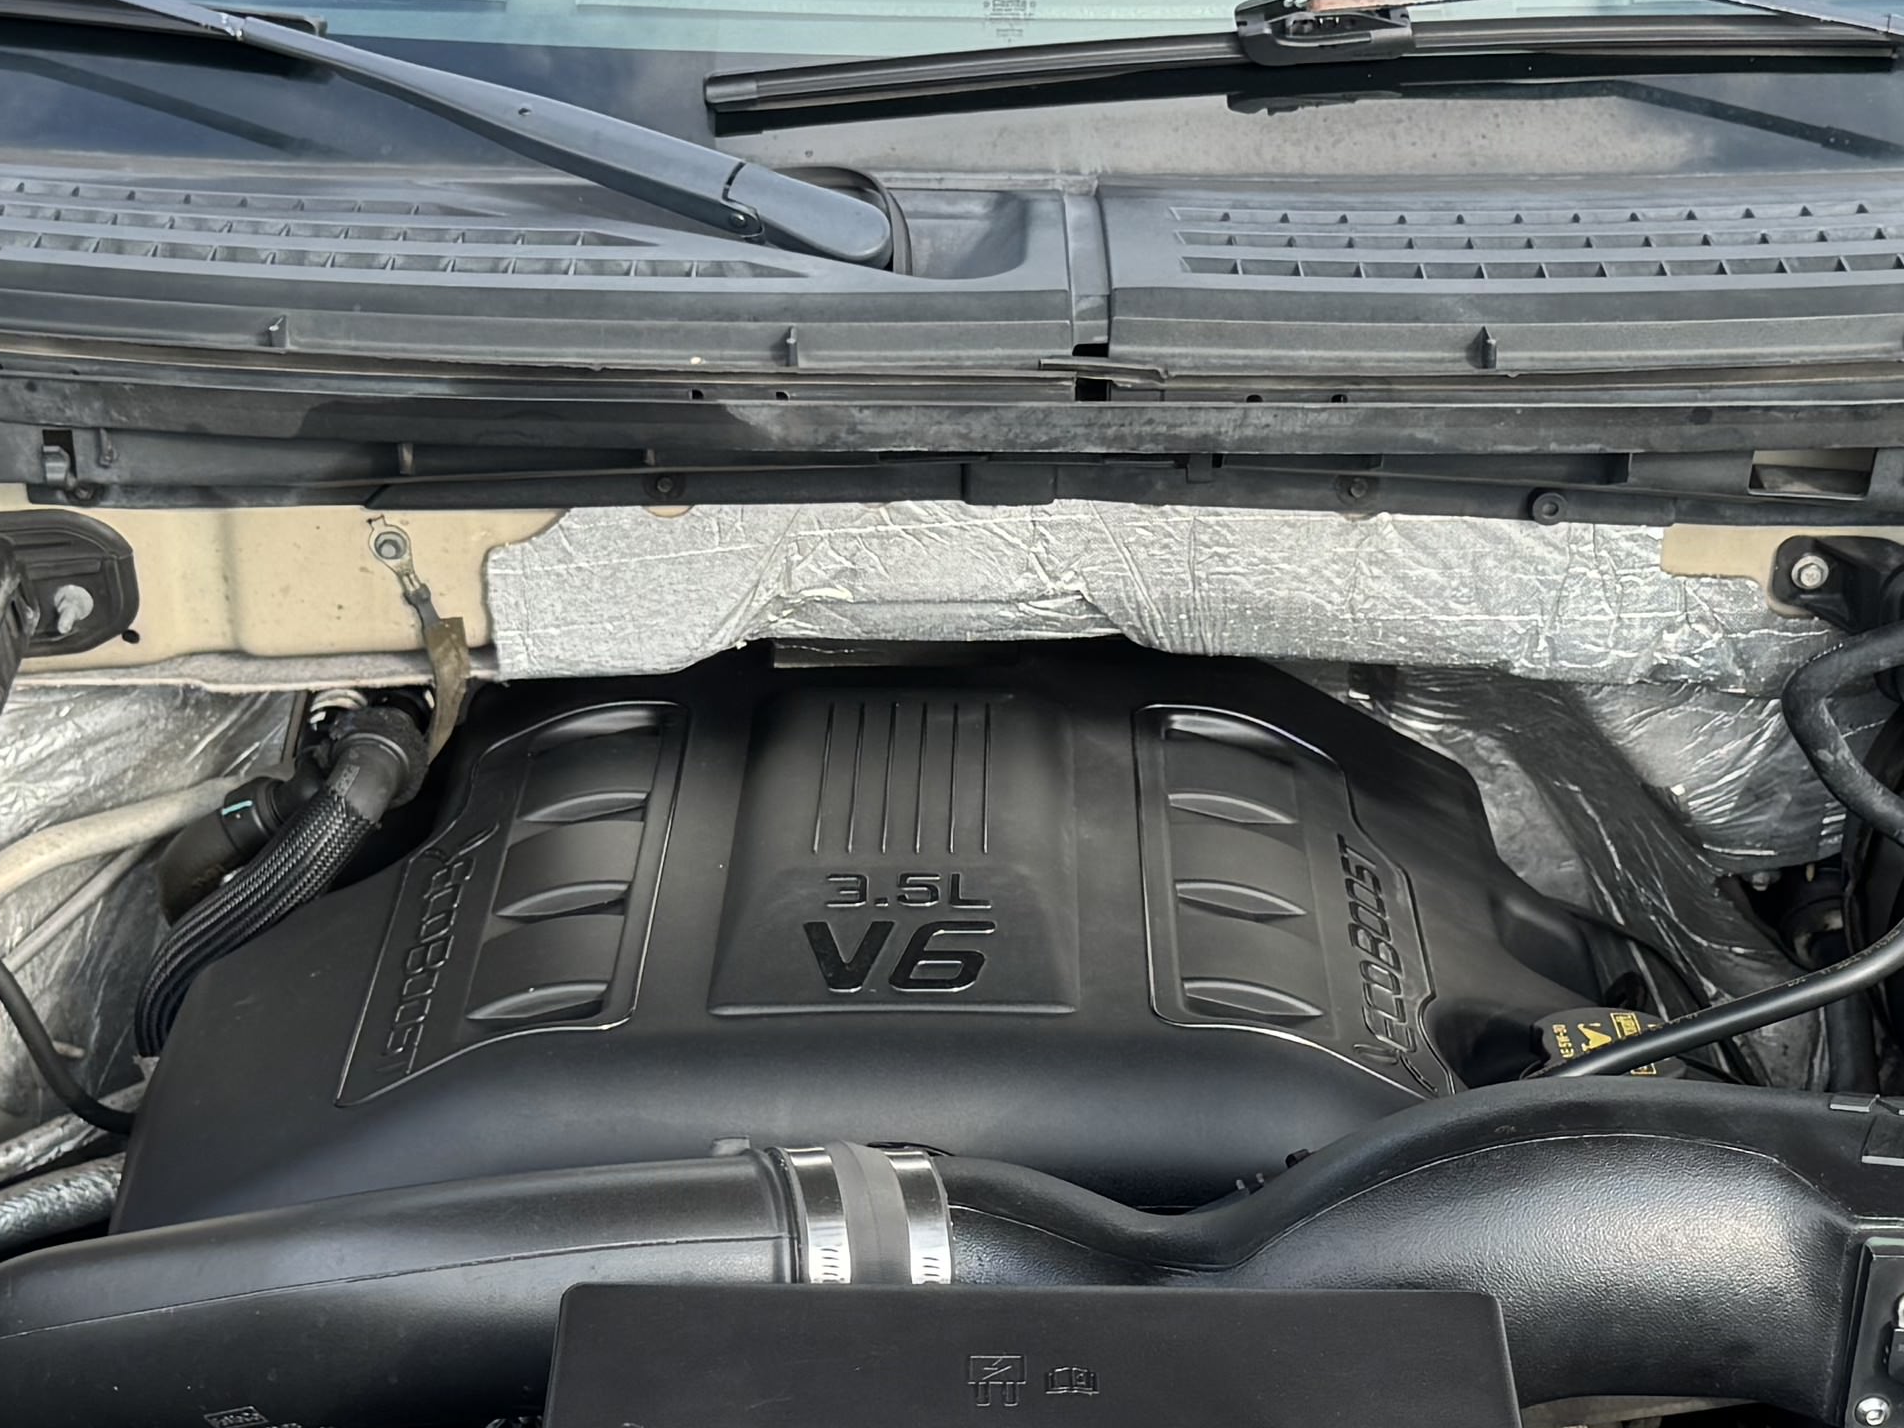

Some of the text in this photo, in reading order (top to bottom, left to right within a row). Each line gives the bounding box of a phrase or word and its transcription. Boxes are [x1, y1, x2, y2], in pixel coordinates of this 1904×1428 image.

[803, 919, 998, 993] V6
[825, 871, 993, 909] 3.5L
[1337, 834, 1417, 1054] ECOBOOST
[376, 857, 476, 1074] ECOBOOST
